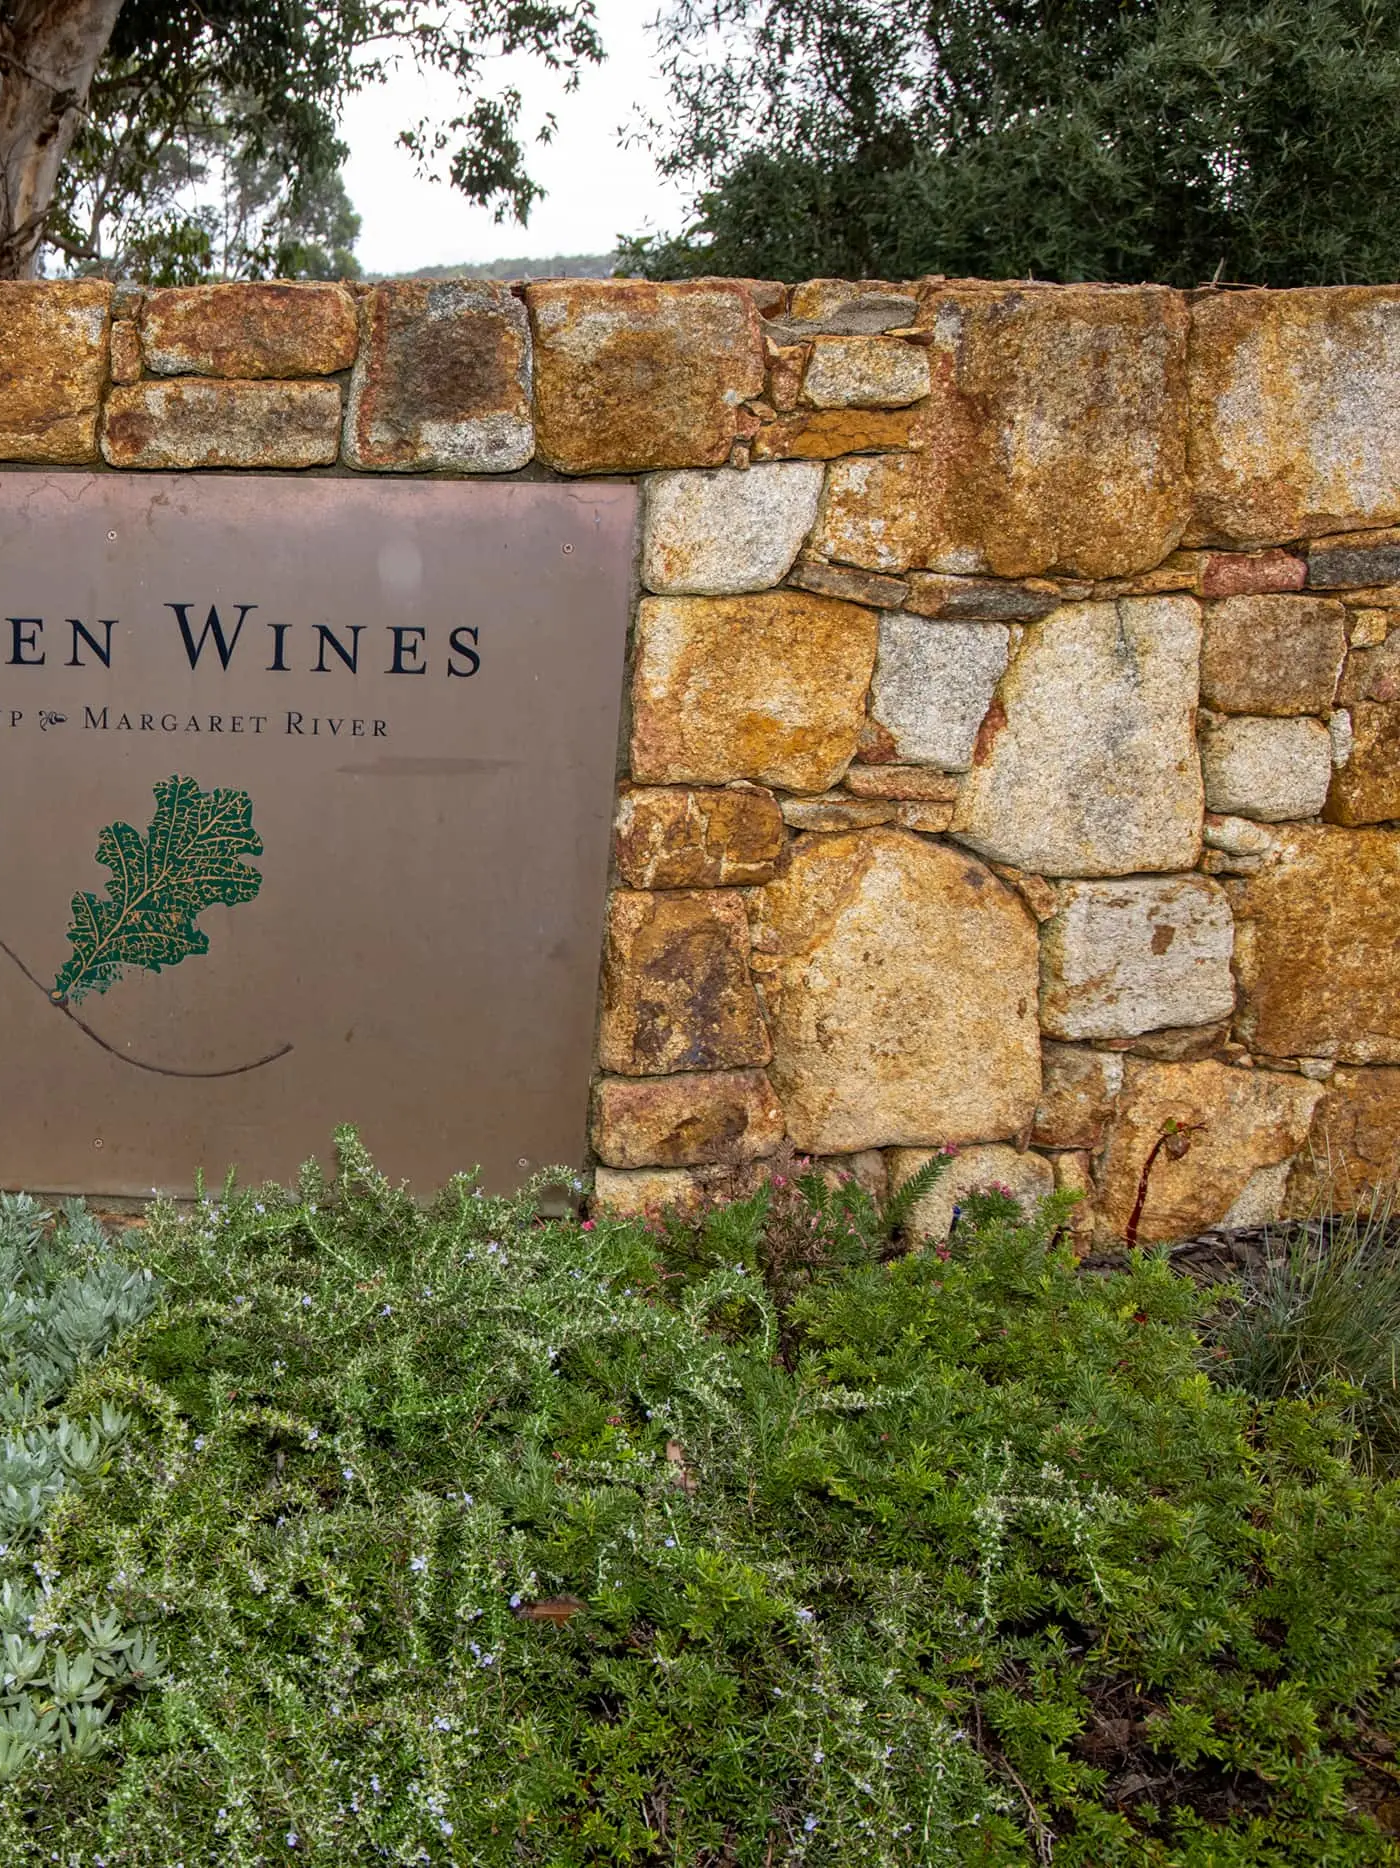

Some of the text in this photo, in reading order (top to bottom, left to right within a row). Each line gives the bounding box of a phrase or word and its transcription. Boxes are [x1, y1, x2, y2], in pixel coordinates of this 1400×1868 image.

[162, 602, 481, 678] WINES
[83, 706, 268, 734] MARGARET
[285, 711, 389, 738] RIVER
